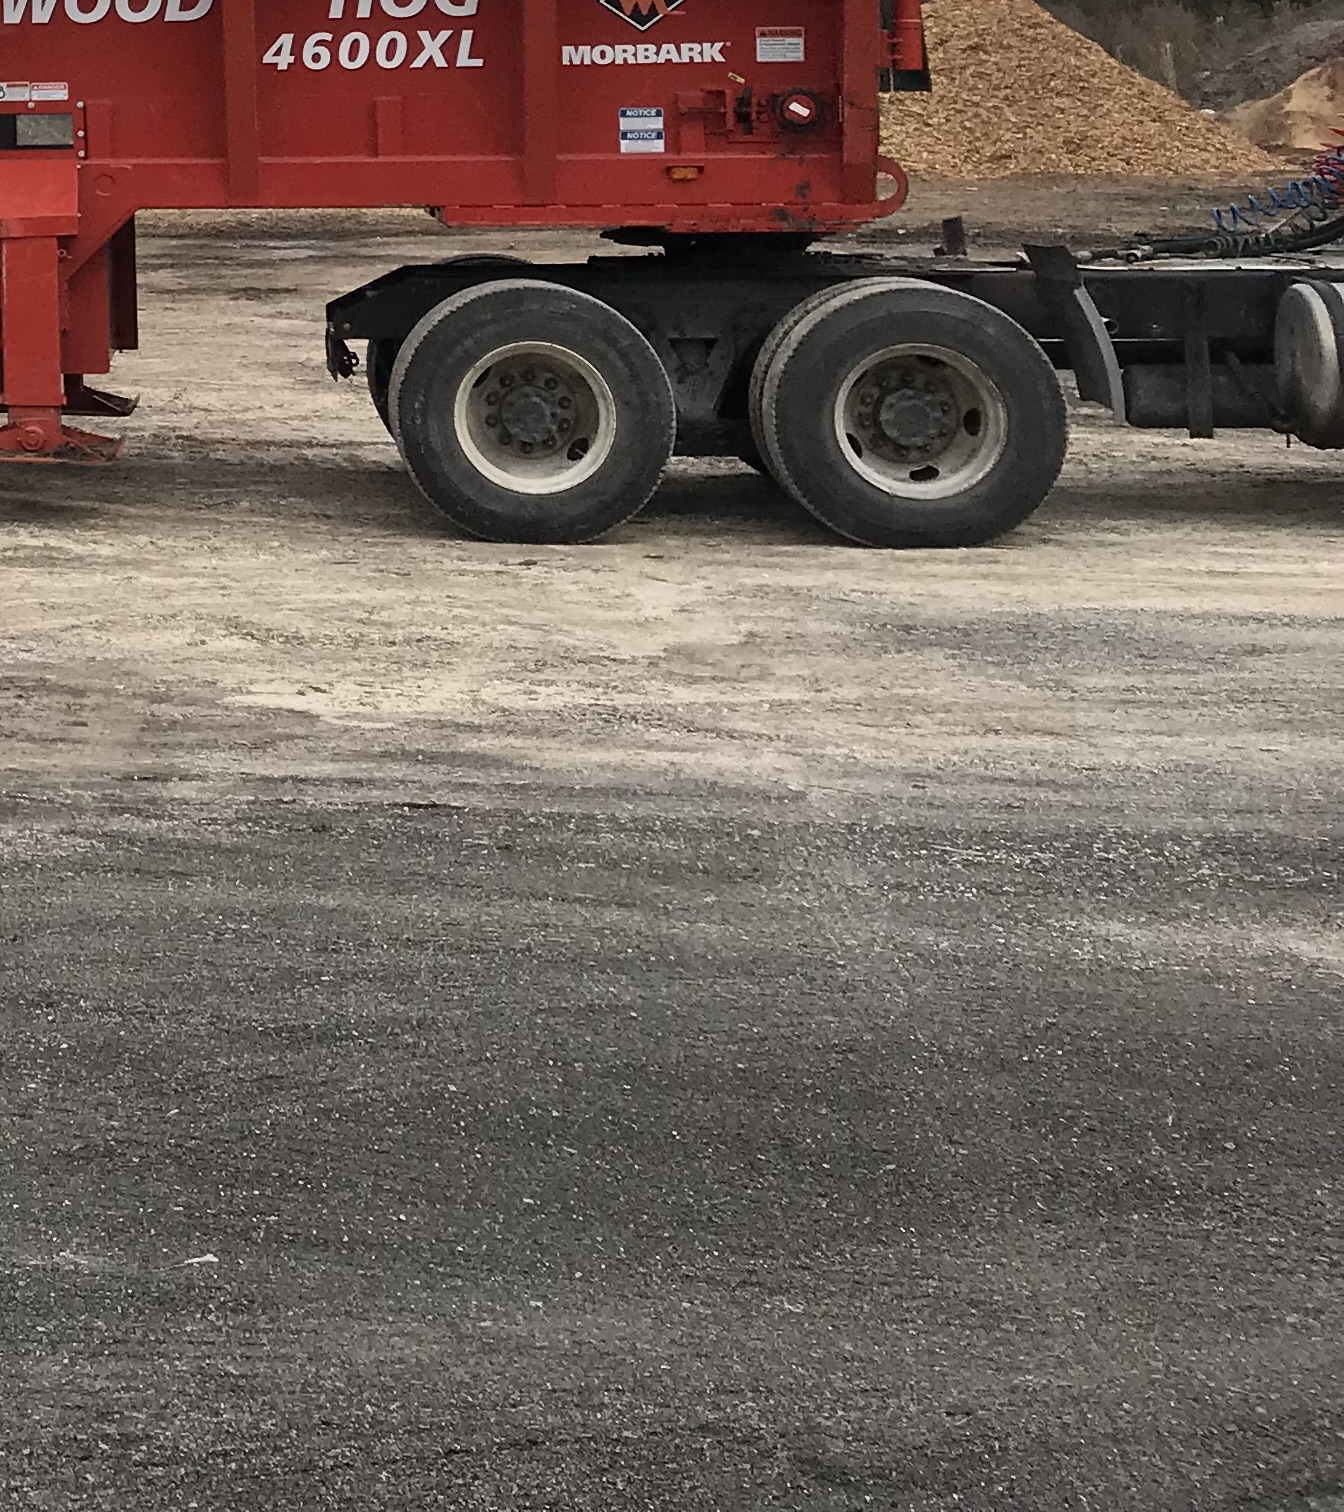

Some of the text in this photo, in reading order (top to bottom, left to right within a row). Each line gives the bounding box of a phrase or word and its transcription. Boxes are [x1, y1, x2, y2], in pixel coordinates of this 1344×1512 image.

[261, 29, 485, 71] 4600XL
[562, 42, 726, 66] MORBARK
[625, 109, 657, 117] NOTICE
